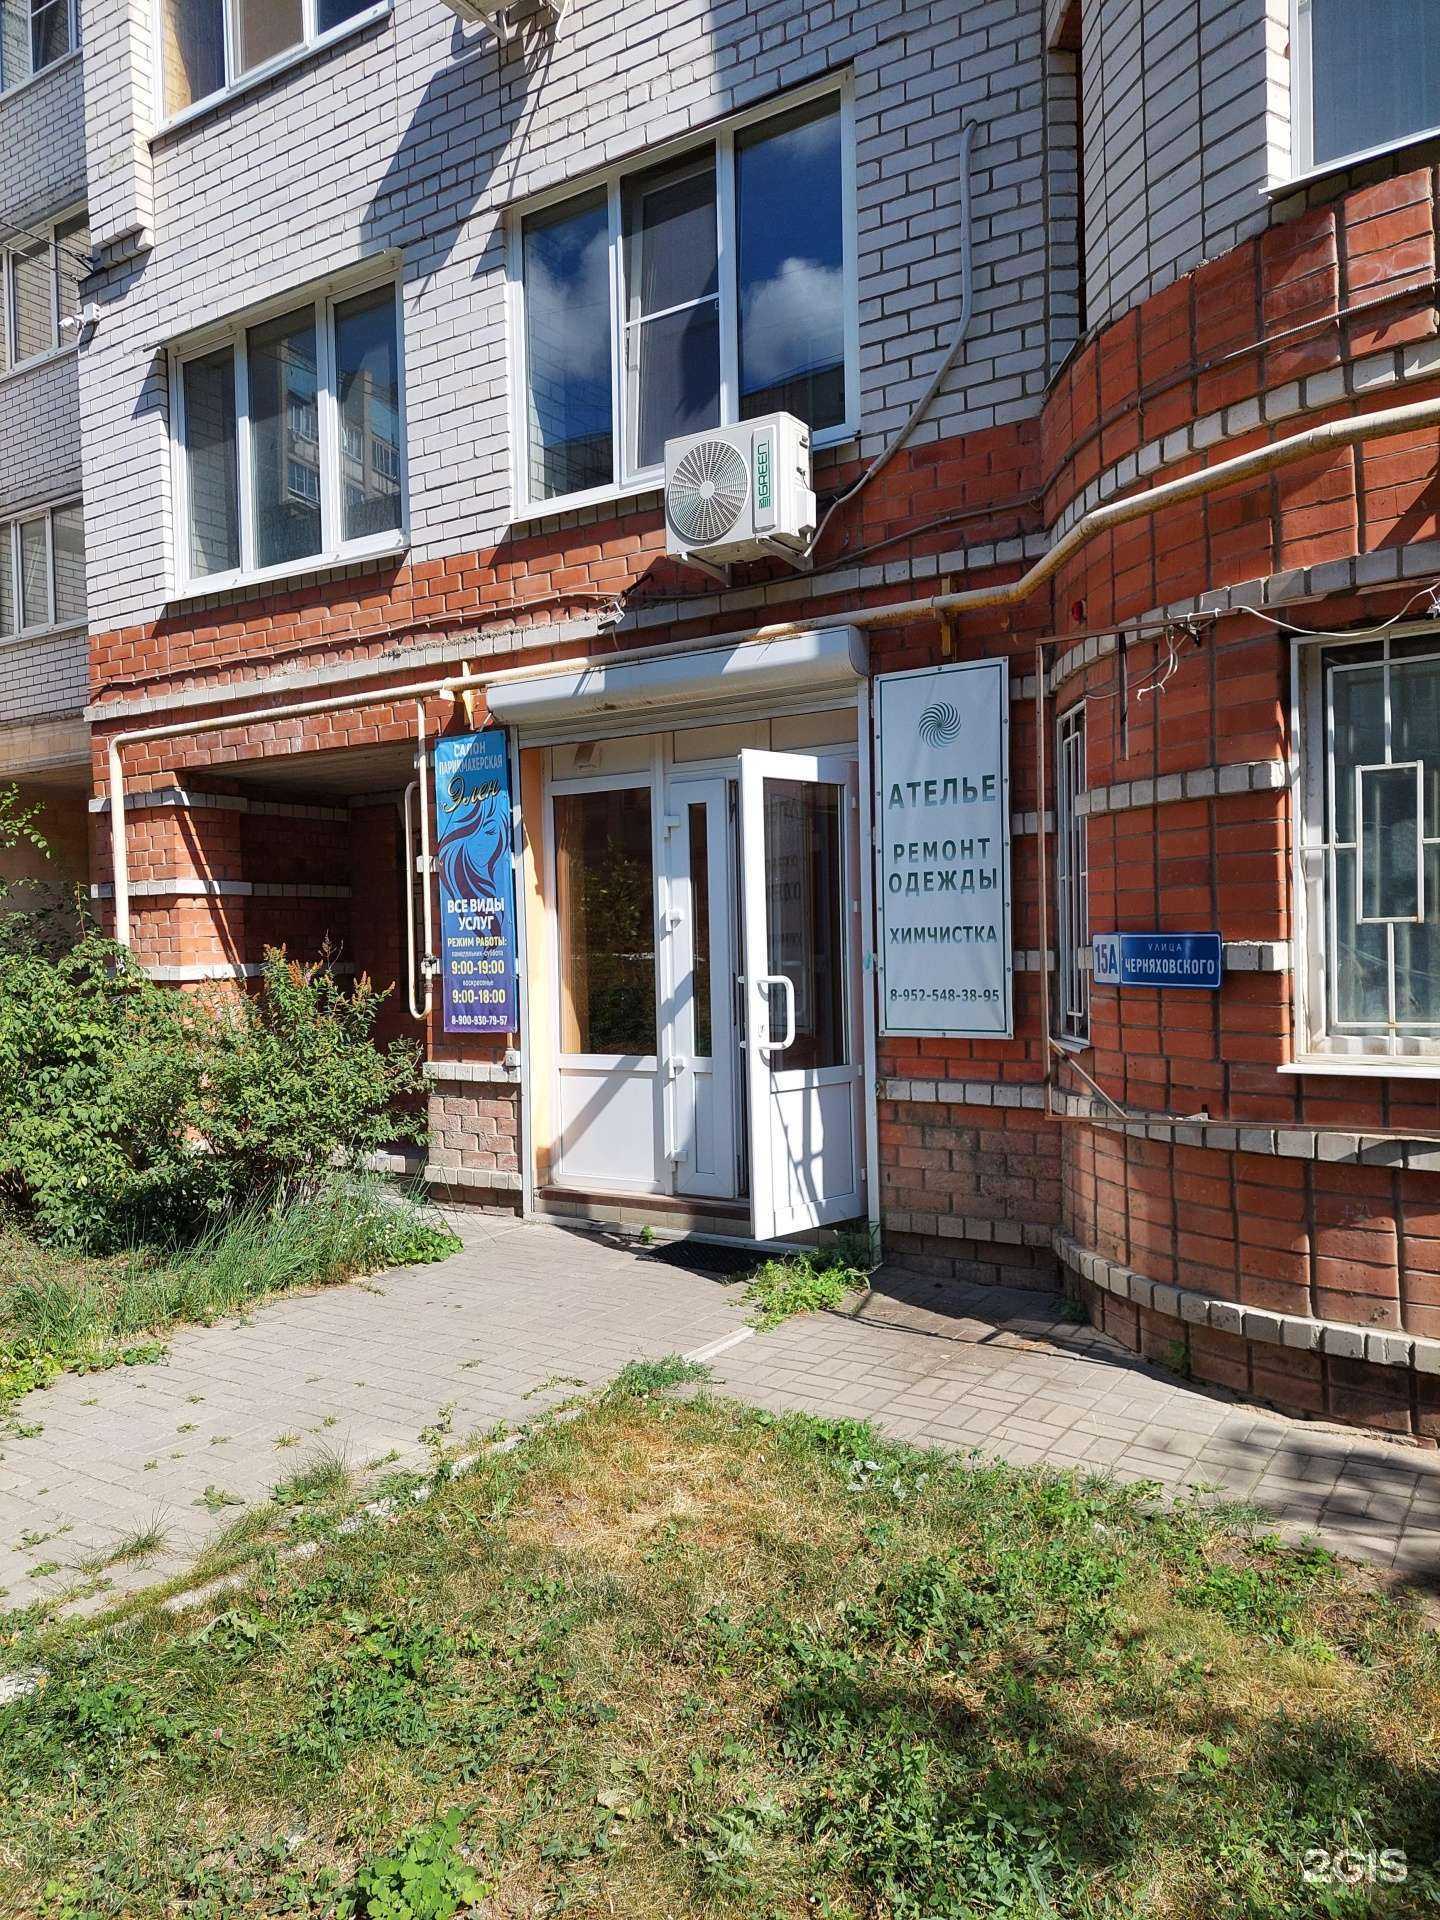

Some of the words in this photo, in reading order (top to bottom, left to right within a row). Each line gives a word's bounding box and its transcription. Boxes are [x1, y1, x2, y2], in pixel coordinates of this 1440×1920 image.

[757, 442, 769, 497] GREEN
[453, 741, 486, 758] САЛОН
[439, 754, 503, 775] ПАРИКМАХЕРСКАЯ
[444, 776, 501, 813] Элен
[888, 774, 997, 810] АТЕЛЬЕ
[892, 837, 991, 865] РЕМОНТ
[888, 868, 998, 897] ОДЕЖДЫ
[447, 898, 468, 914] ВСЕ
[470, 897, 505, 914] ВИДЫ
[458, 915, 494, 931] УСЛУГ
[447, 937, 474, 948] РЕЖИМ
[475, 936, 507, 947] РАБОТЫ:
[889, 924, 998, 945] ХИМЧИСТКА
[1147, 943, 1183, 952] УЛИЦА
[451, 960, 505, 975] 9:00-19:00
[1094, 943, 1118, 975] 15А
[1124, 958, 1215, 975] ЧЕРНЯХОВСКОГО
[452, 989, 506, 1004] 9:00-18:00
[889, 988, 1000, 1003] 8-952-548-38-95
[451, 1015, 508, 1025] 8-900-930-79-57
